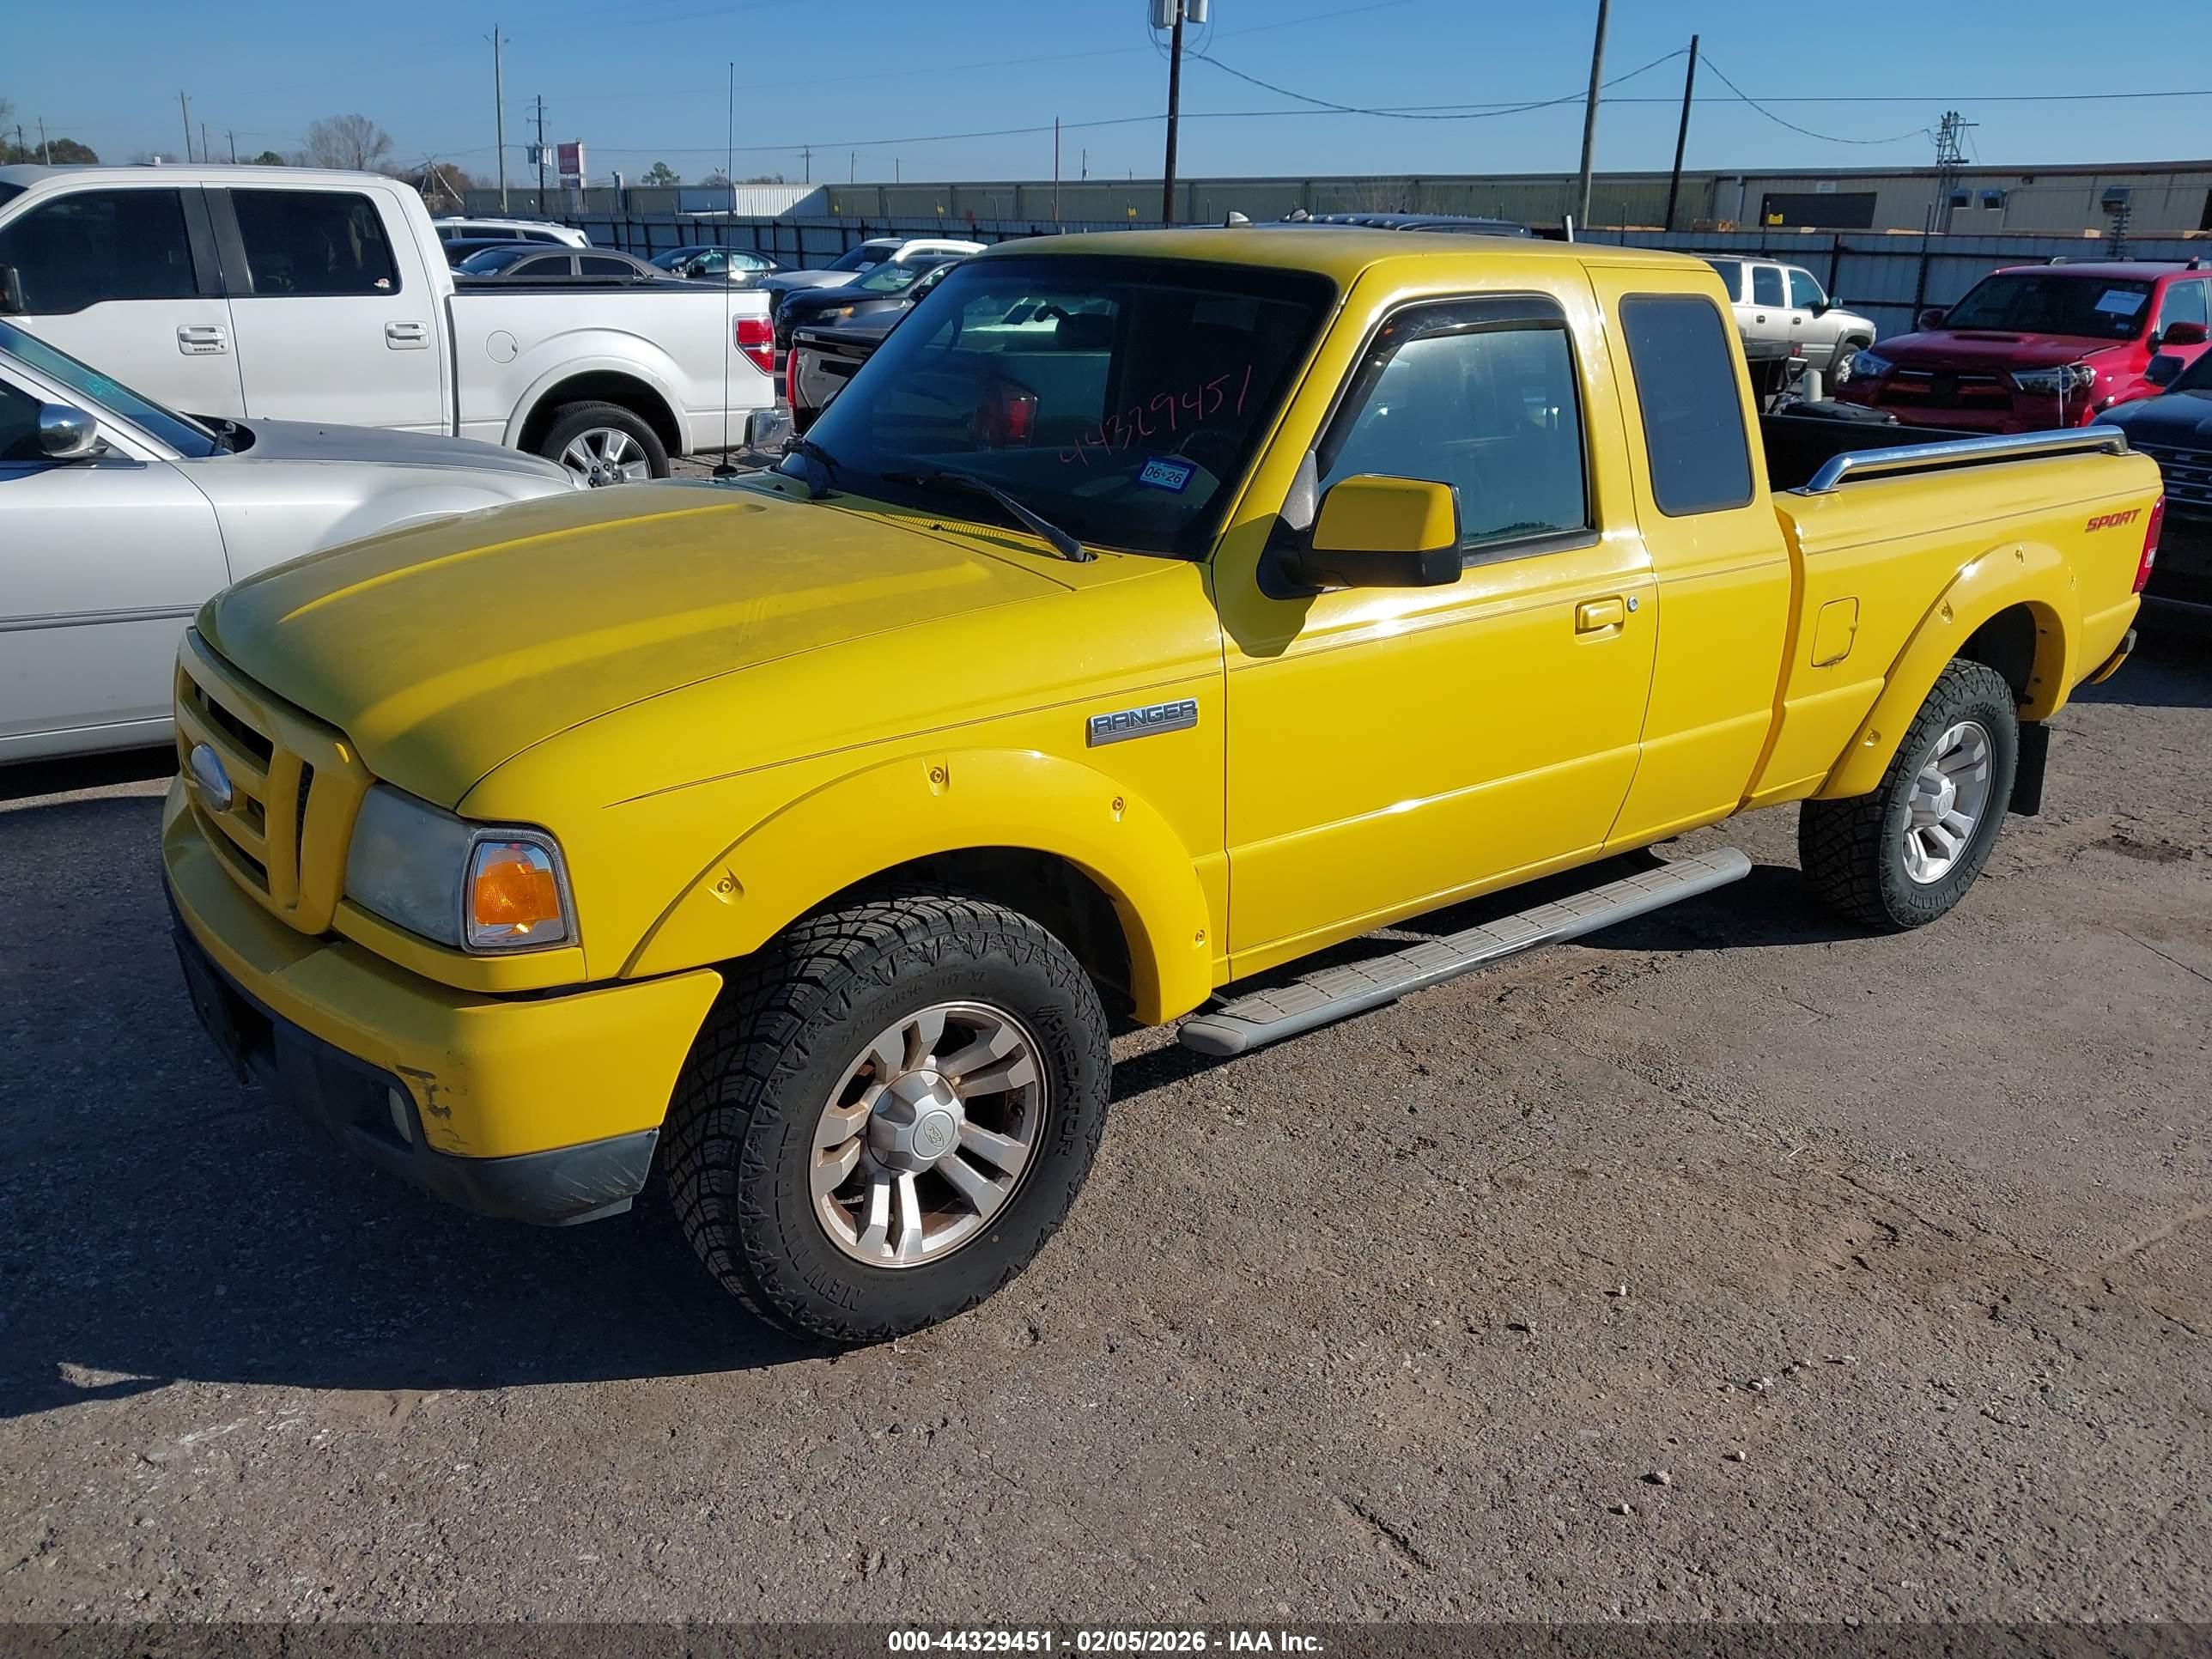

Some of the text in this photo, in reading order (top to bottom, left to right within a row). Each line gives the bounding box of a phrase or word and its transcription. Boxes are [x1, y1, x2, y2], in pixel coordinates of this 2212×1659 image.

[1060, 365, 1252, 465] 44329451
[2085, 508, 2142, 533] SPORT
[1093, 700, 1198, 734] RANGER
[1040, 1013, 1081, 1158] PREDATOR
